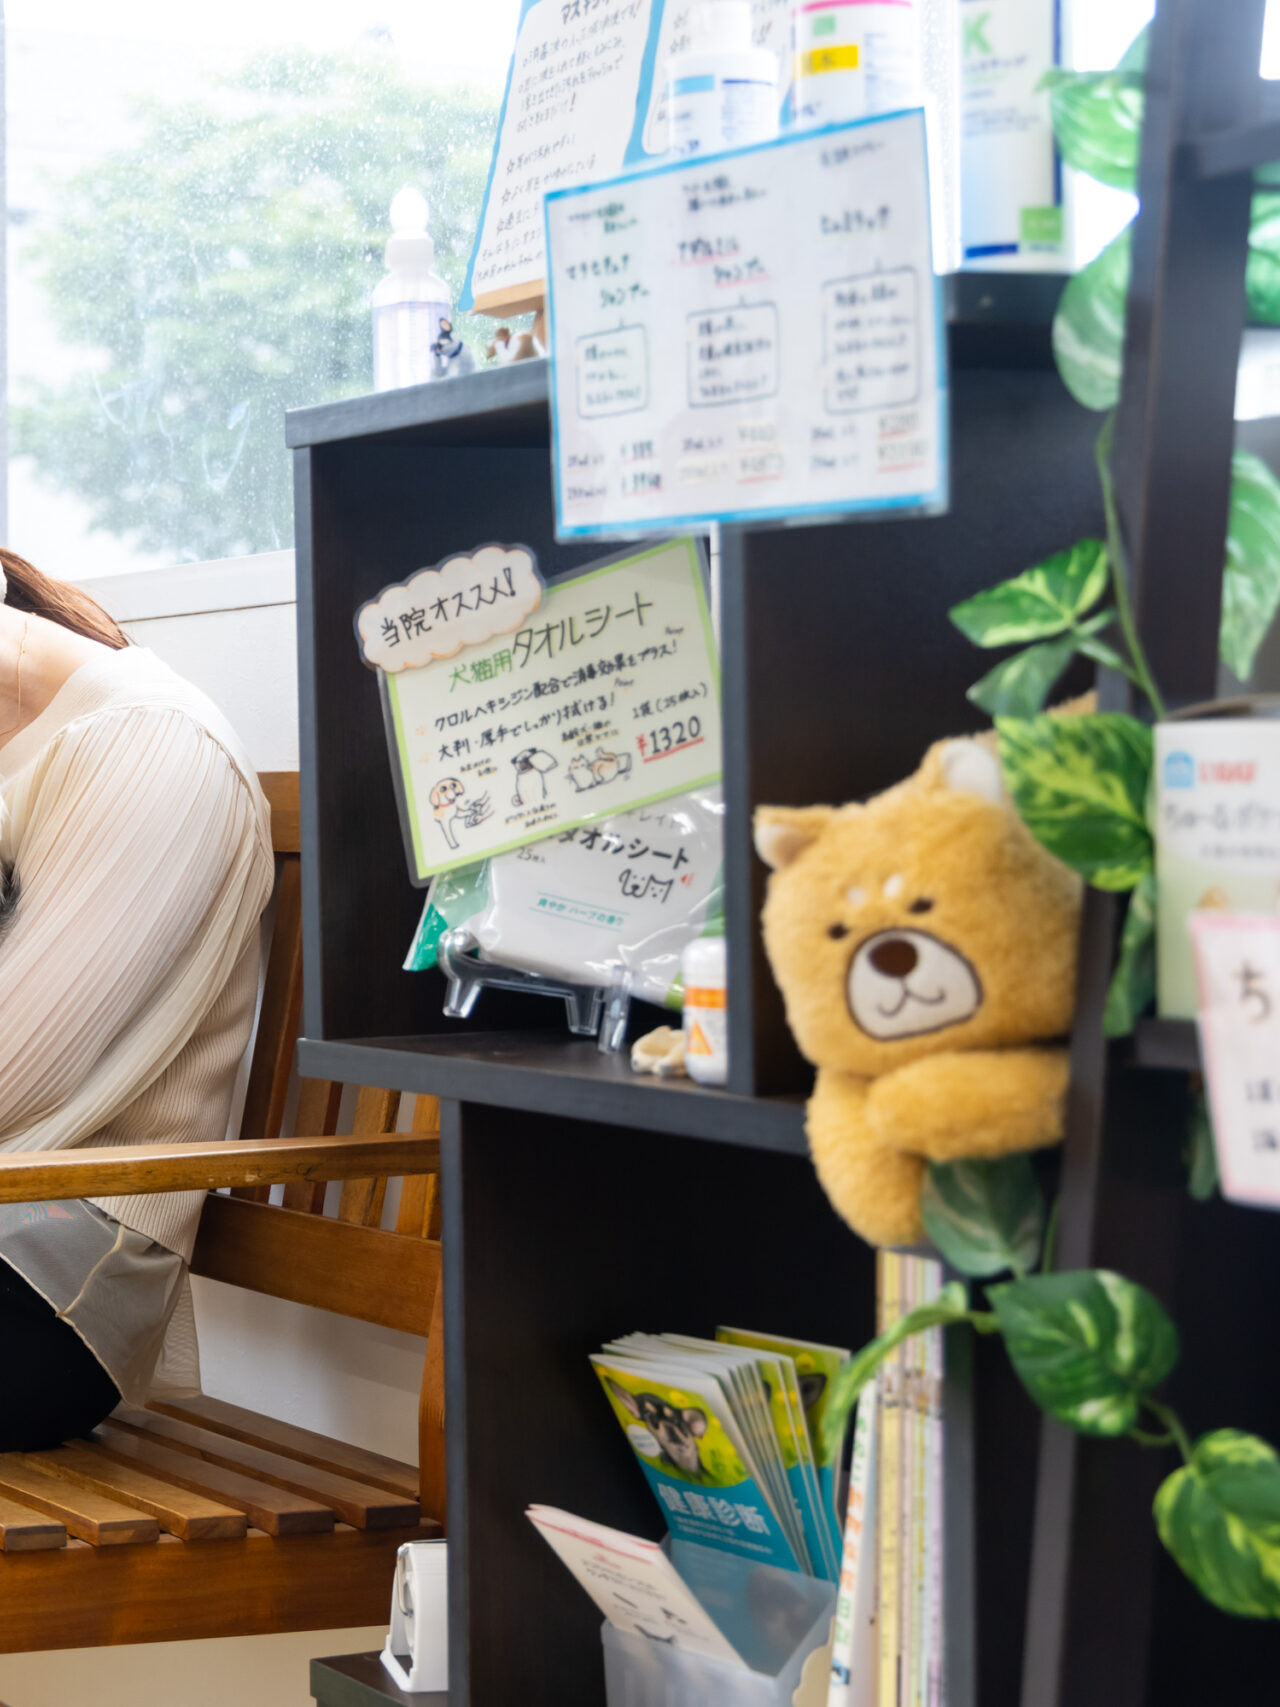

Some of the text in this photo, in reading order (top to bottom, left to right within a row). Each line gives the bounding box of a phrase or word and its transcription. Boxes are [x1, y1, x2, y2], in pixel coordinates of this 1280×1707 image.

[380, 567, 517, 648] 当院オススメ!
[635, 715, 702, 757] ¥1320
[657, 1482, 771, 1536] 健康診断
